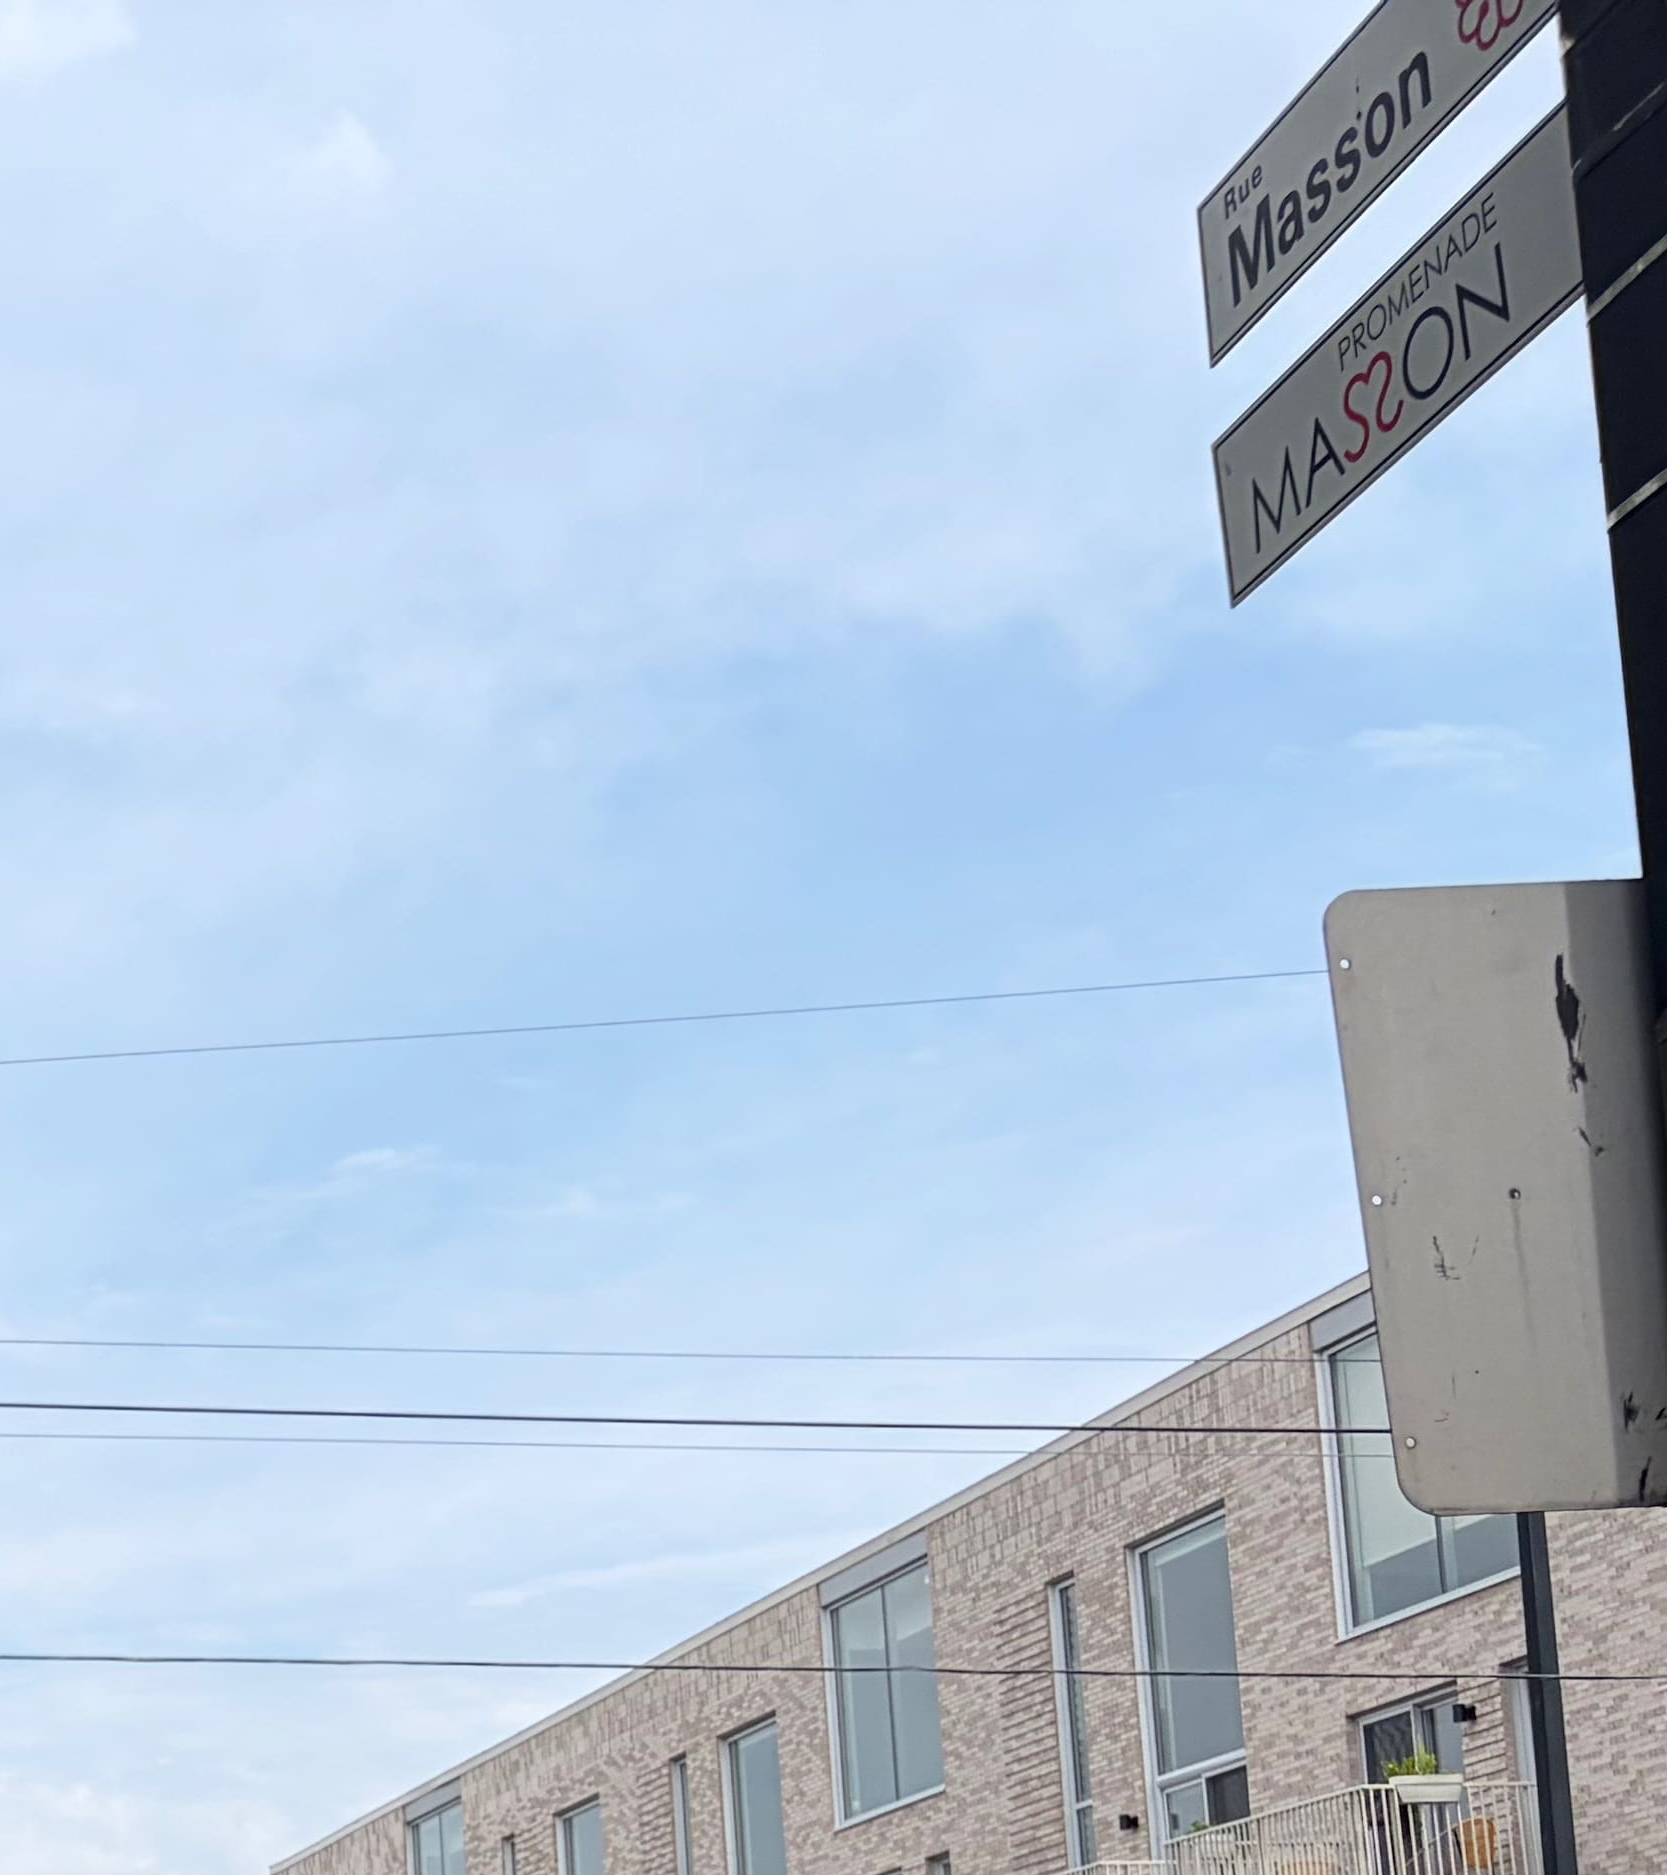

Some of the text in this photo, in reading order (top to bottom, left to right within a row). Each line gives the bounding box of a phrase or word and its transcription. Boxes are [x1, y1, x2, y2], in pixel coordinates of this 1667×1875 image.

[1222, 164, 1264, 220] Rue
[1225, 50, 1432, 307] Masson
[1338, 191, 1499, 372] PROMENADE
[1253, 242, 1511, 554] MASSON
